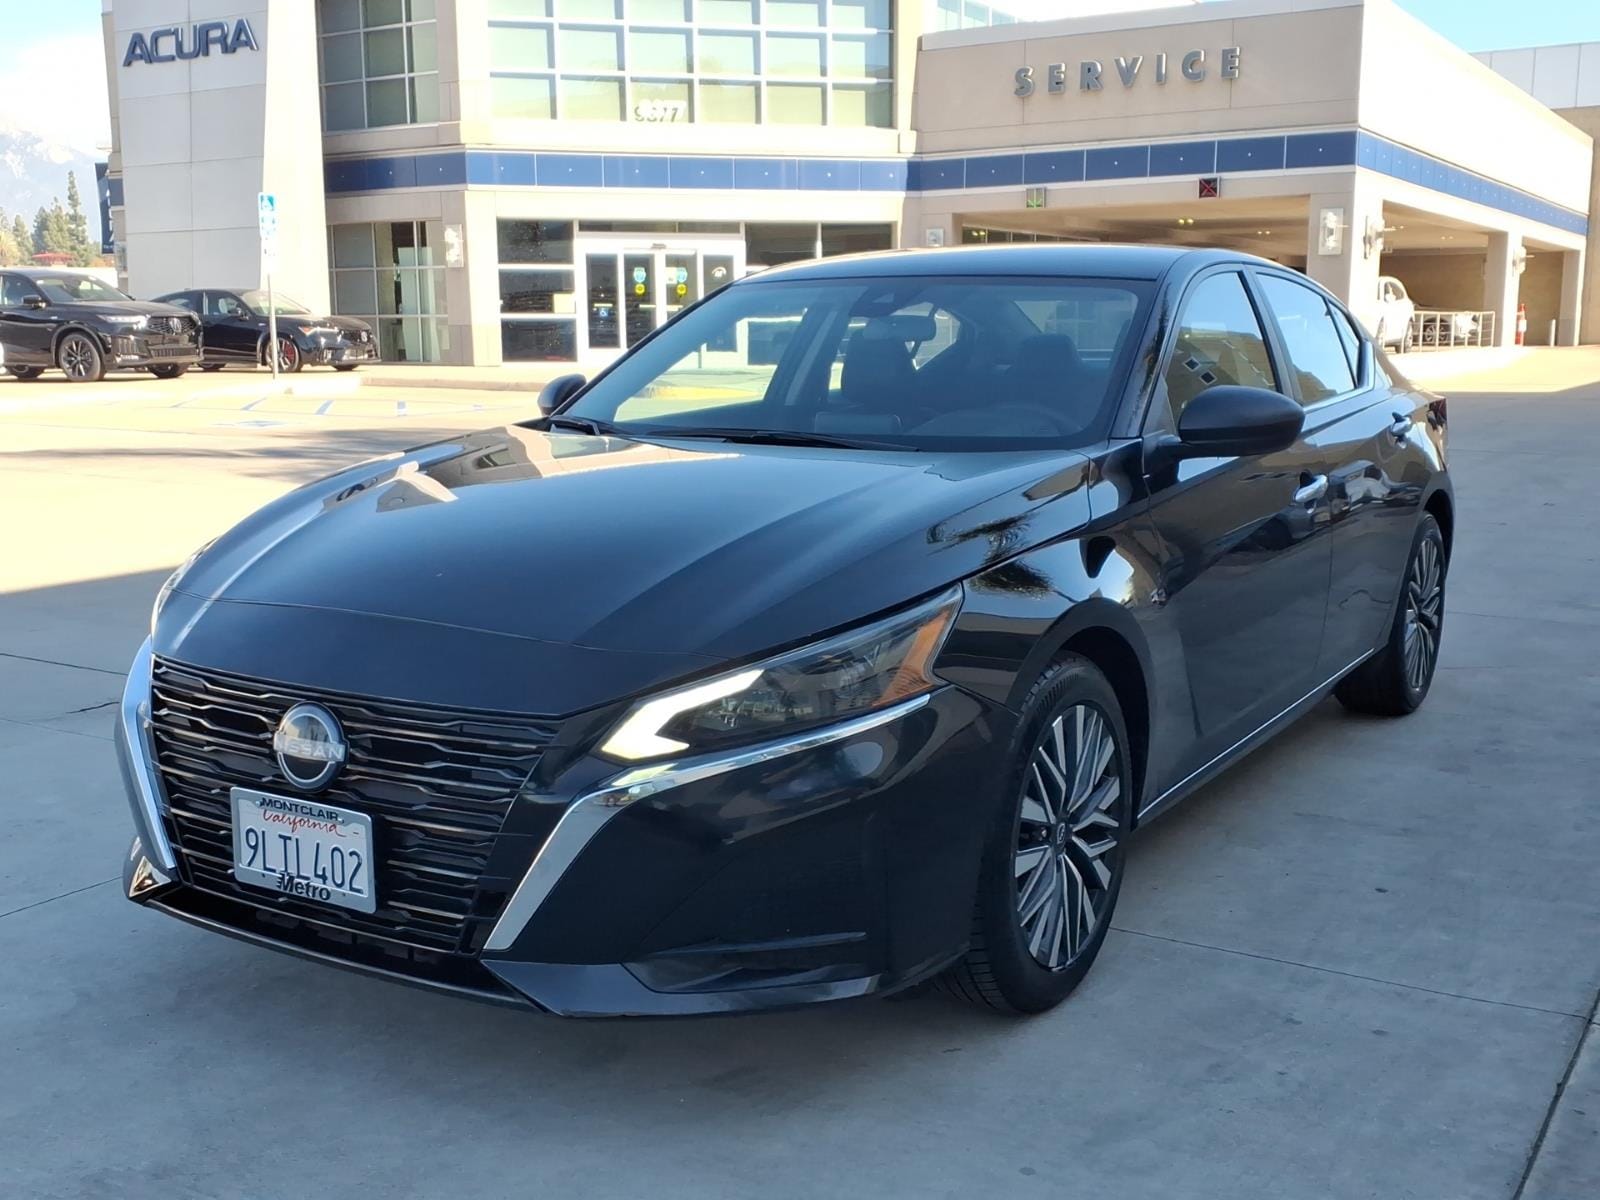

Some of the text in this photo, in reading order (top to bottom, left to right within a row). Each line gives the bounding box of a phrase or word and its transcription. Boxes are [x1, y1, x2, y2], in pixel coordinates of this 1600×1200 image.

[123, 18, 259, 67] ACURA
[1014, 46, 1241, 97] SERVICE
[275, 734, 345, 761] NISSAN
[260, 798, 340, 821] MONTCLAIR
[276, 872, 332, 901] Metro
